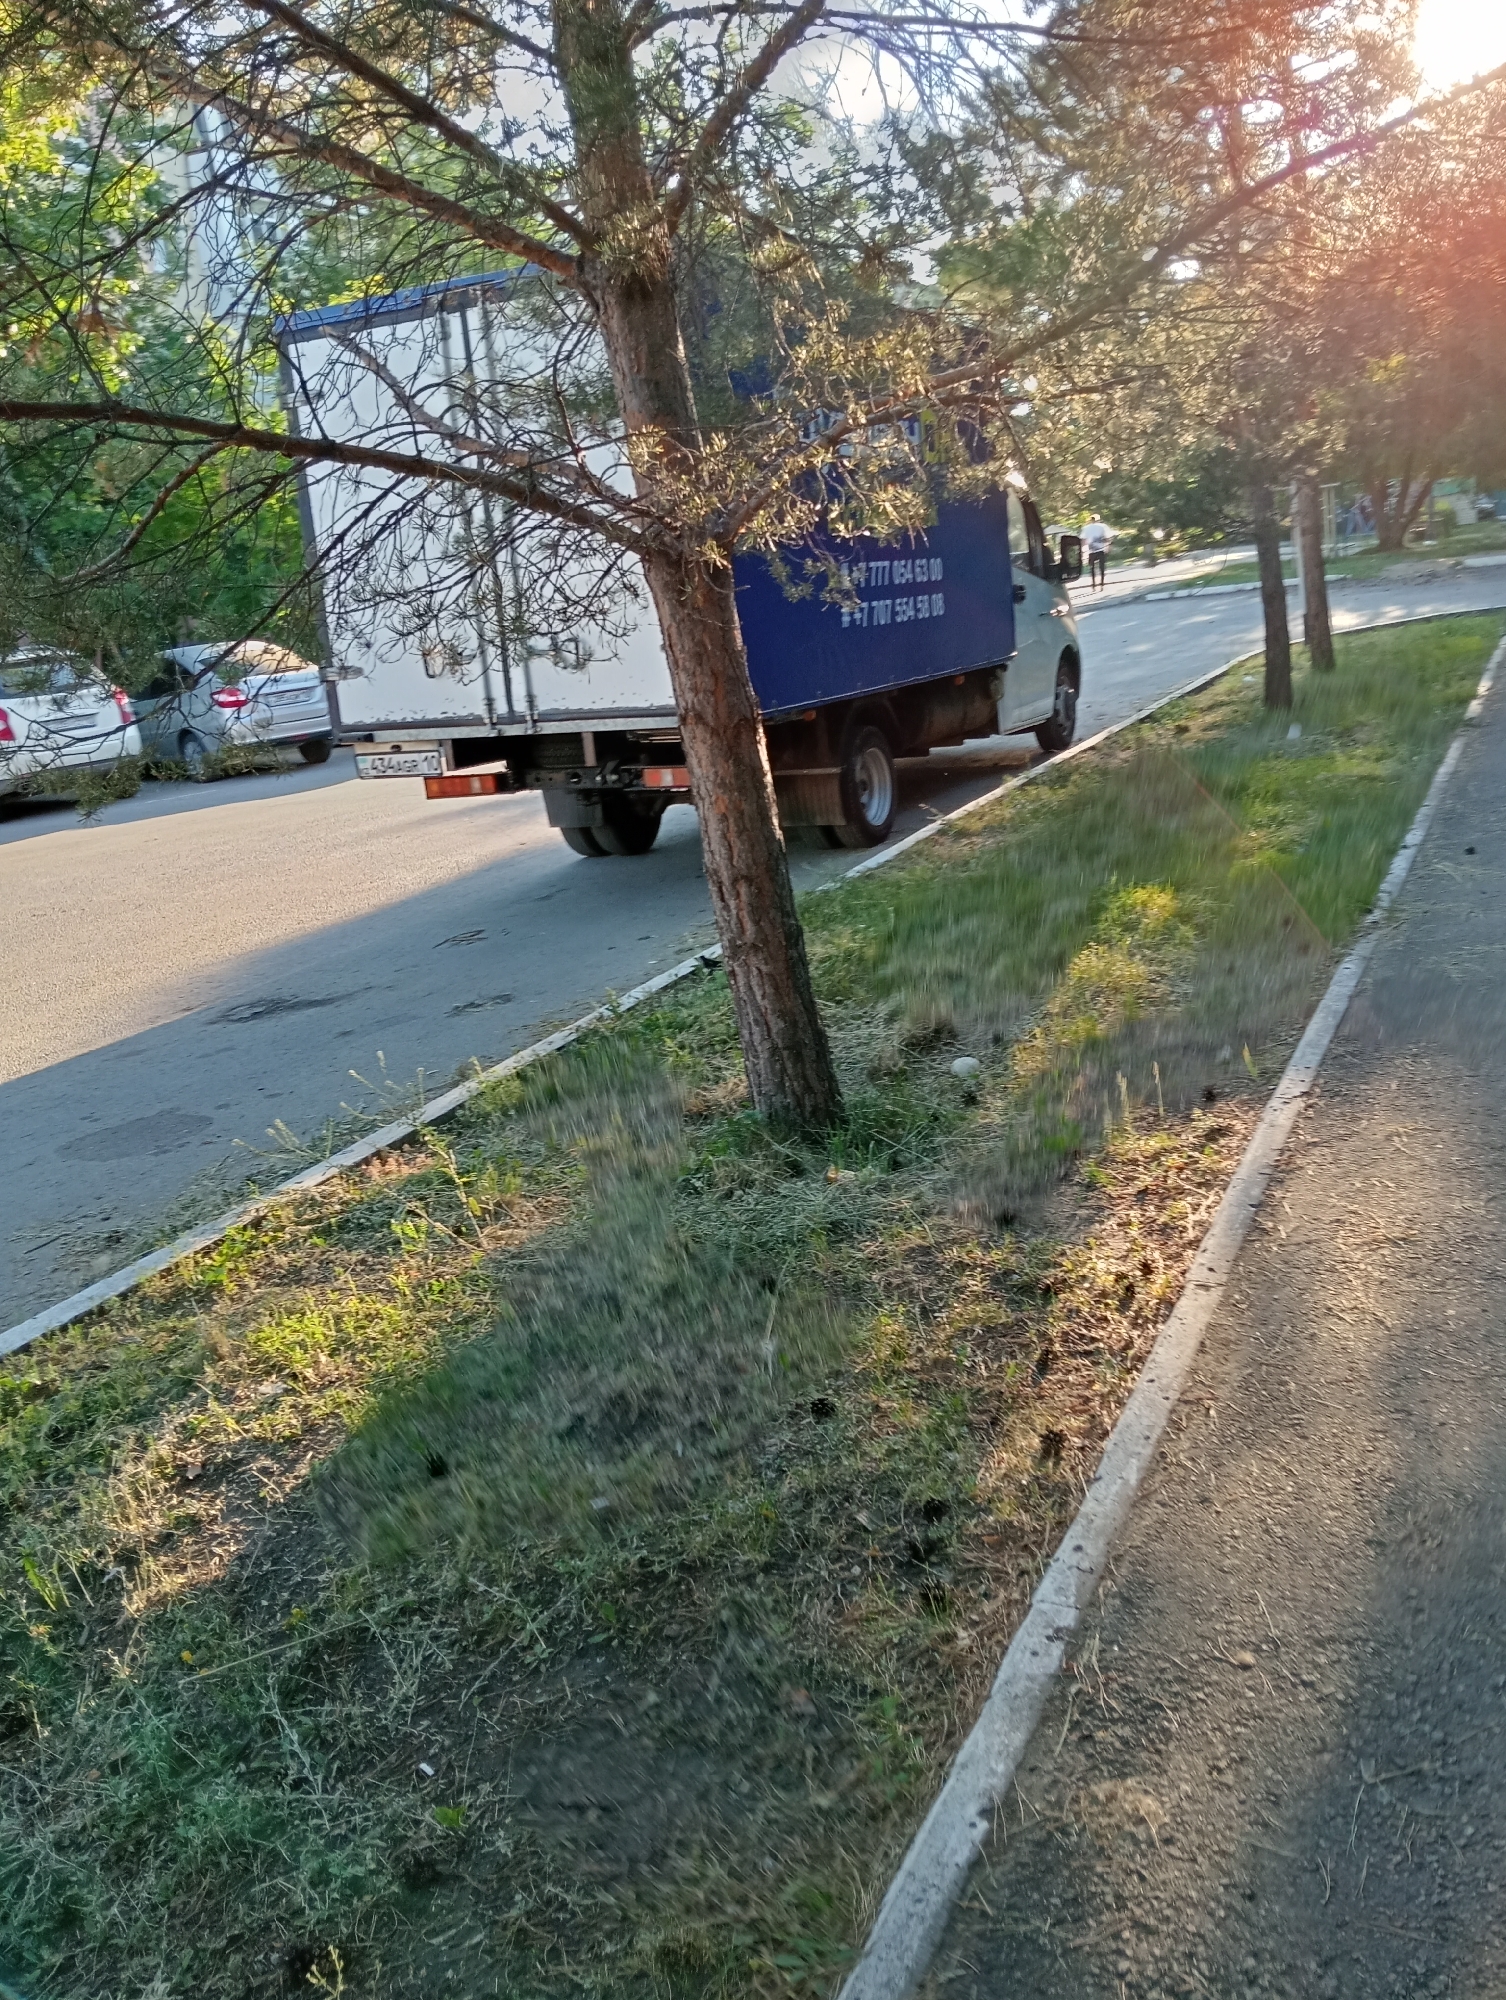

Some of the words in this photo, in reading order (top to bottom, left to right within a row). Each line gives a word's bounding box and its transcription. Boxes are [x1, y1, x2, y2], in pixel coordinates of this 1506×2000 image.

[869, 561, 890, 587] 777
[914, 558, 929, 583] 63
[929, 557, 943, 582] 00
[871, 599, 893, 626] 707
[895, 597, 915, 622] 554
